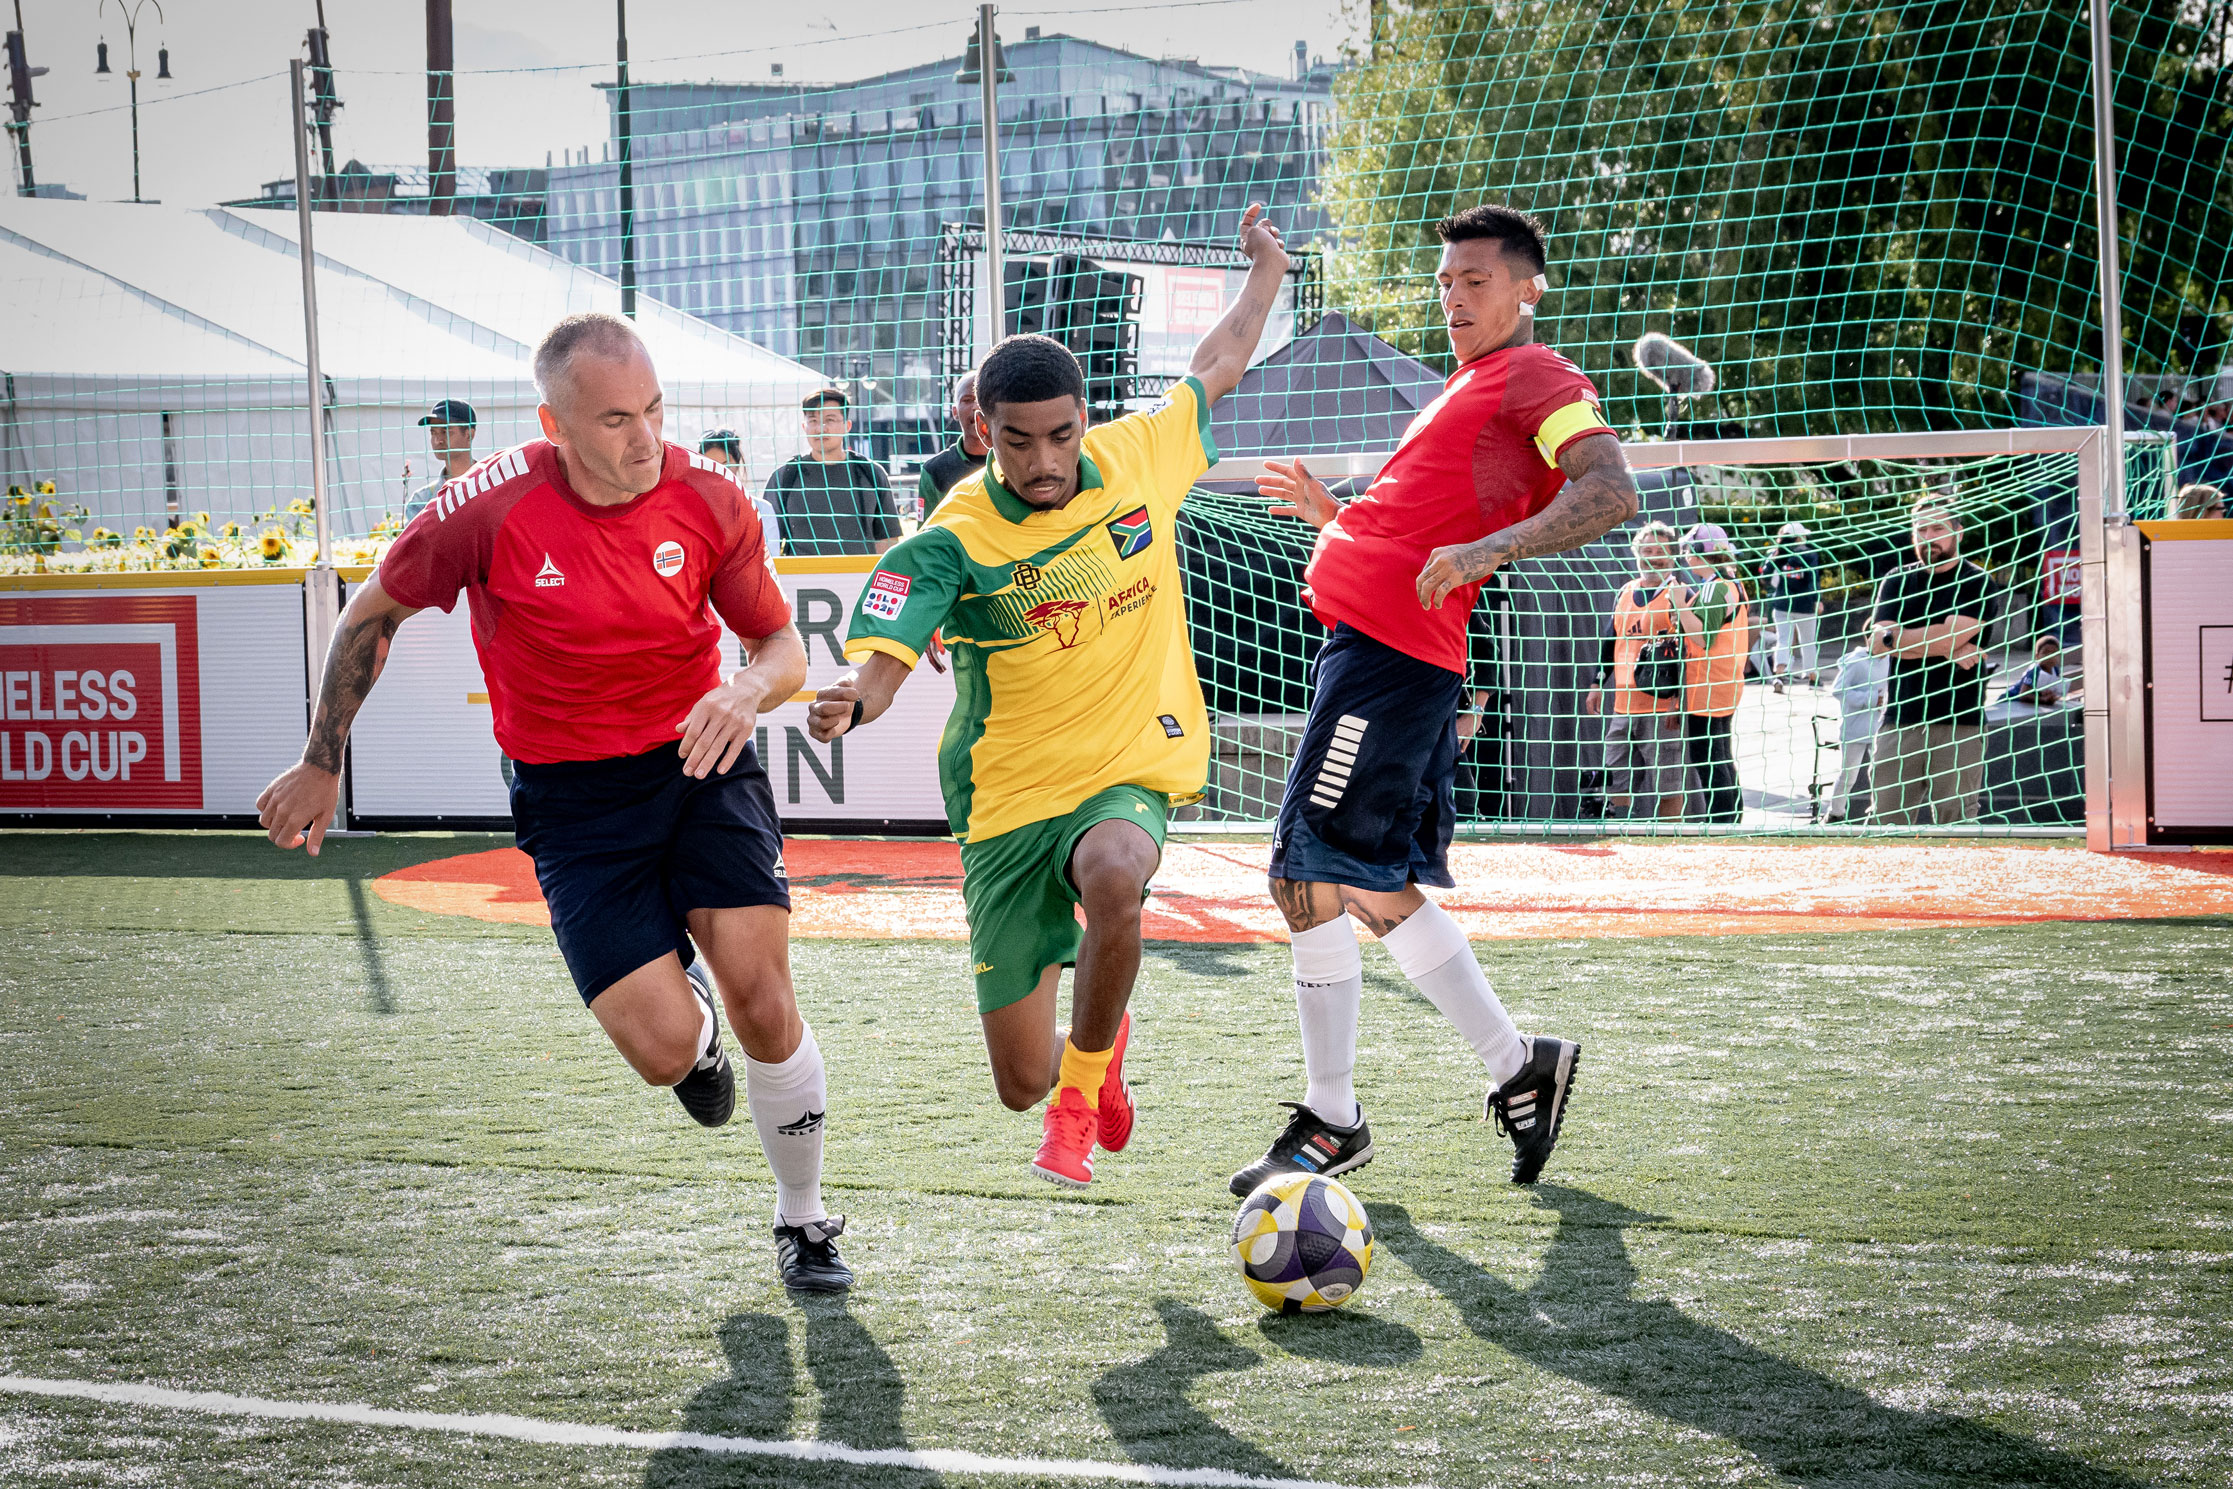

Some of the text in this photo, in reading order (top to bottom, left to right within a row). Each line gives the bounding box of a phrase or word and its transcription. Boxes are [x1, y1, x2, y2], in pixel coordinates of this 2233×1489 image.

[535, 577, 565, 587] SELECT
[1108, 576, 1150, 610] AFRICA
[0, 669, 137, 721] ELESS
[61, 730, 147, 782] CUP
